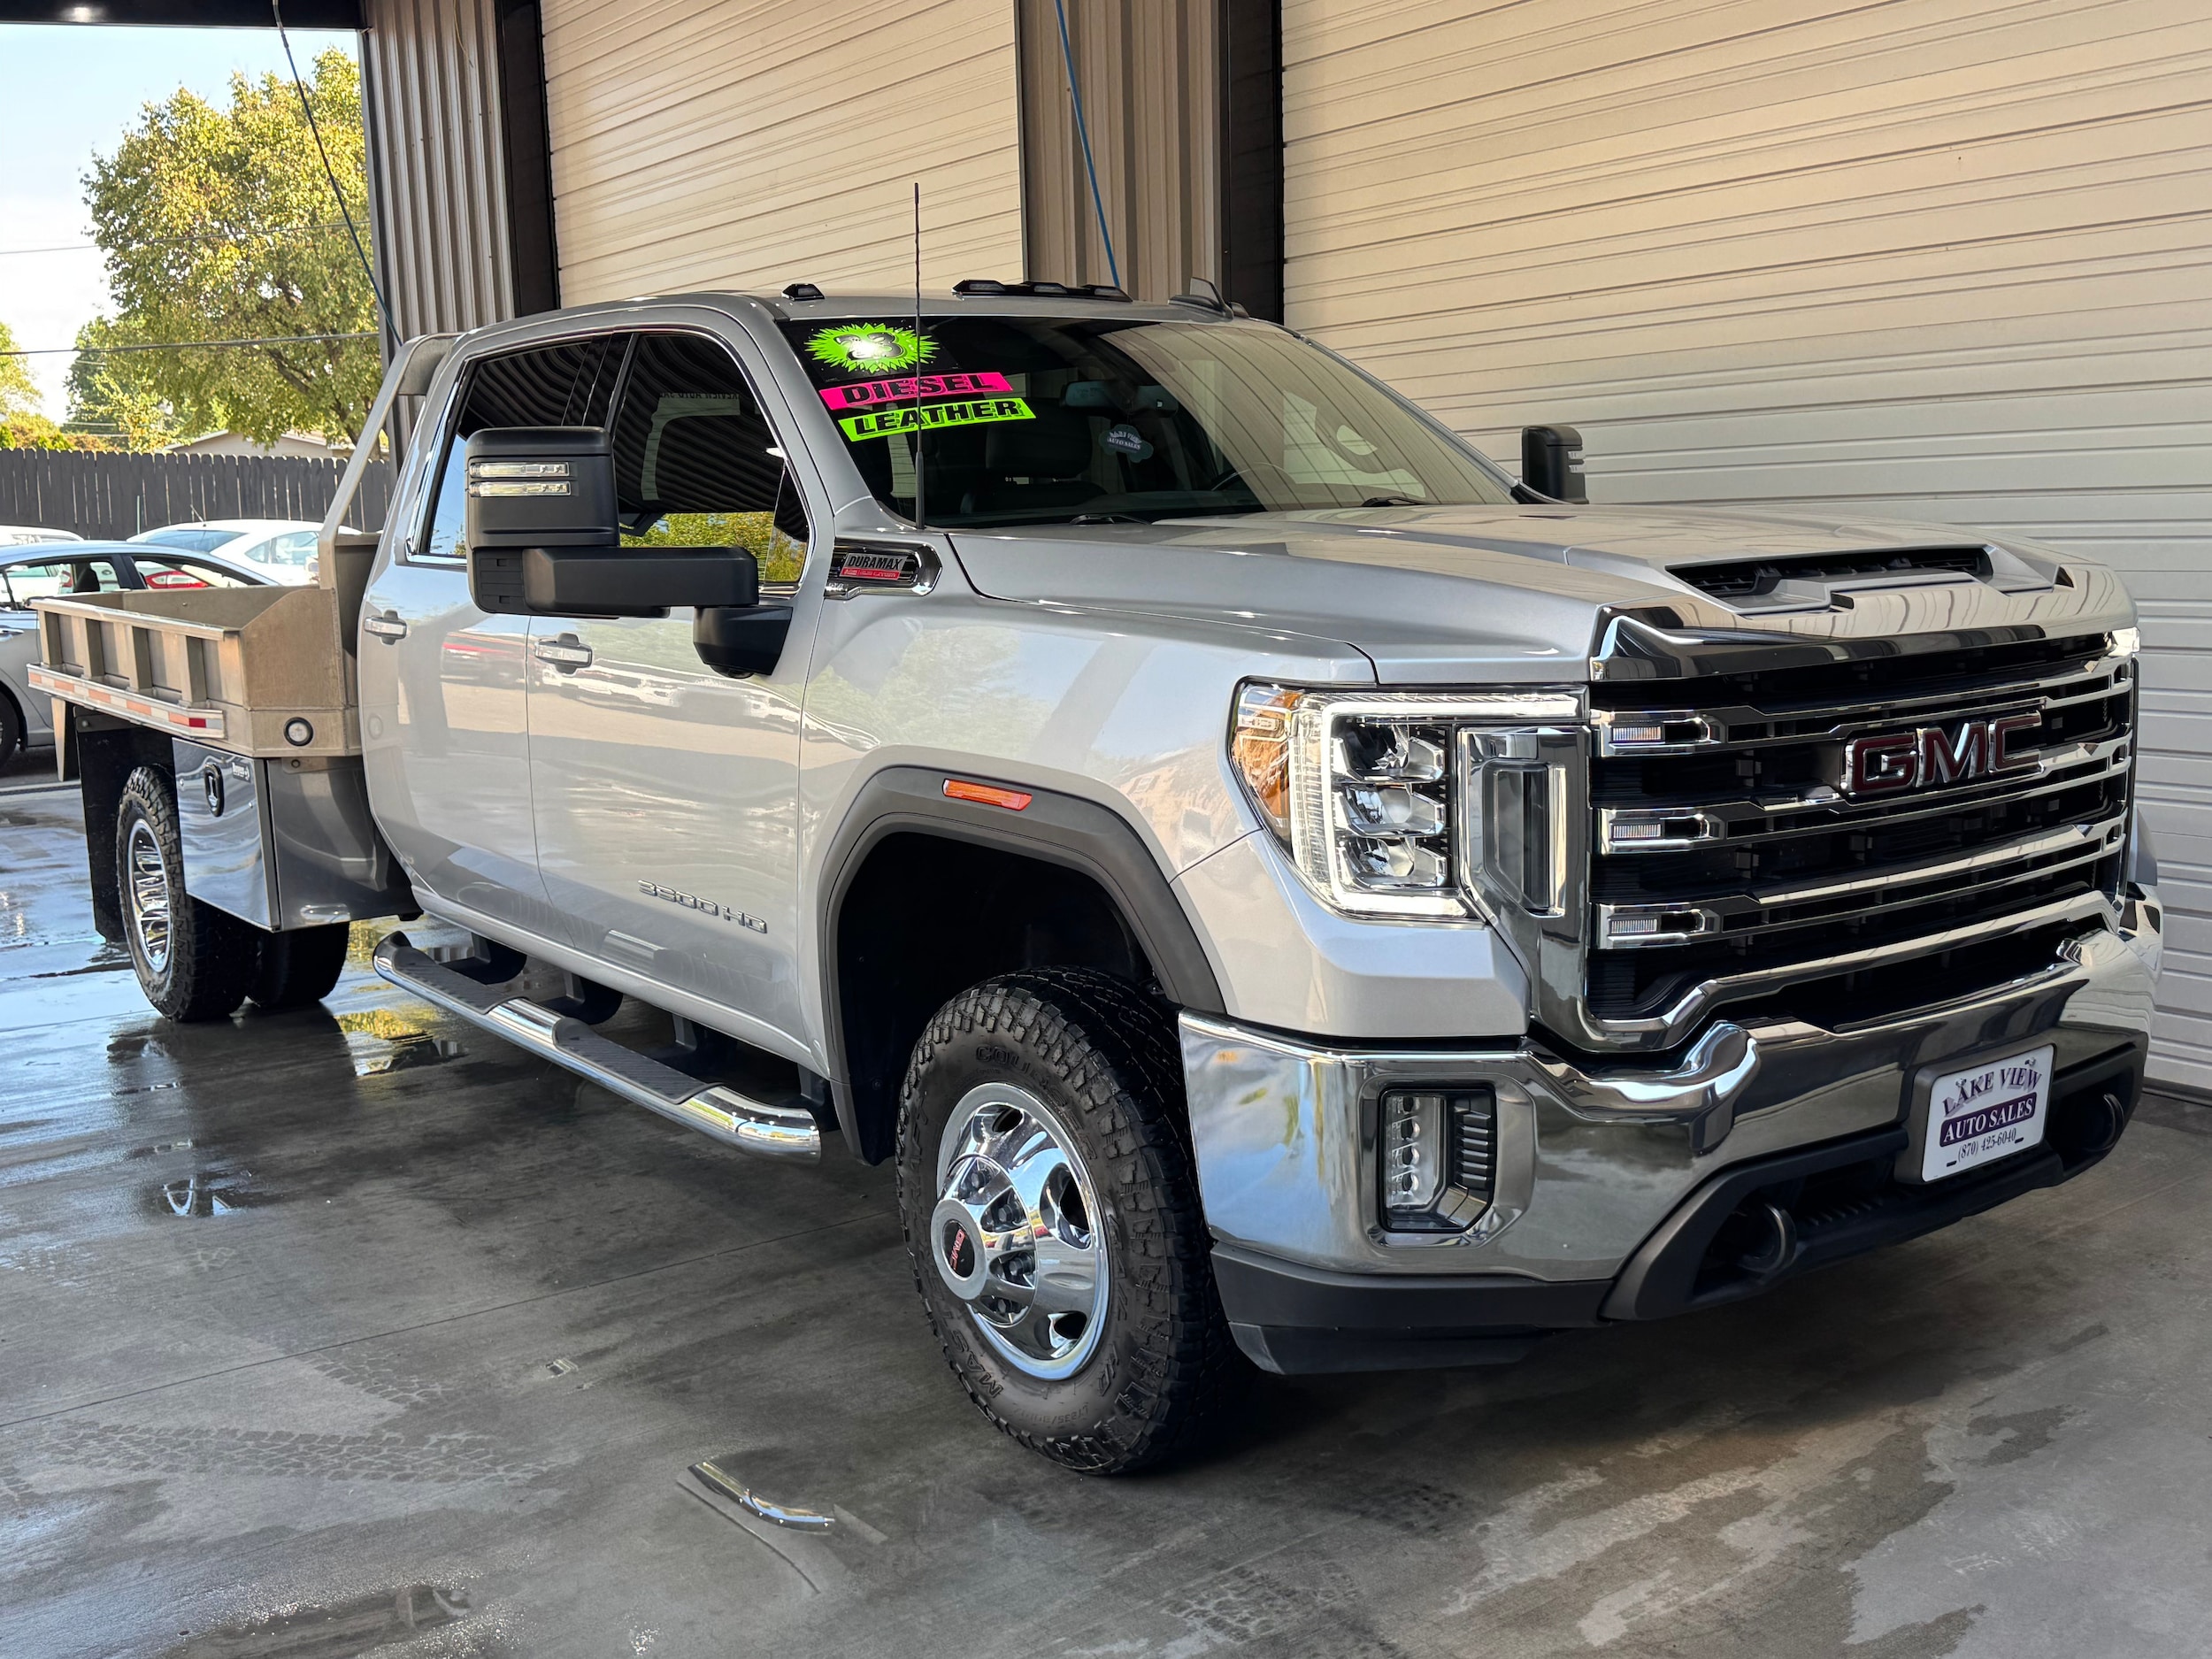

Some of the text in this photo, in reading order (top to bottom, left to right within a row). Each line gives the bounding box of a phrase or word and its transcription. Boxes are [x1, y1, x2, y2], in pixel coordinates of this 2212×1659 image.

[841, 374, 997, 403] DIESEL
[855, 400, 1022, 436] LEATHER
[848, 556, 902, 570] DURAMAX
[1840, 710, 2044, 795] GMC
[1942, 1067, 2042, 1118] LAKE VIEW
[1944, 1097, 2033, 1143] AUTO SALES
[1957, 1127, 2017, 1163] (870) 425-6040
